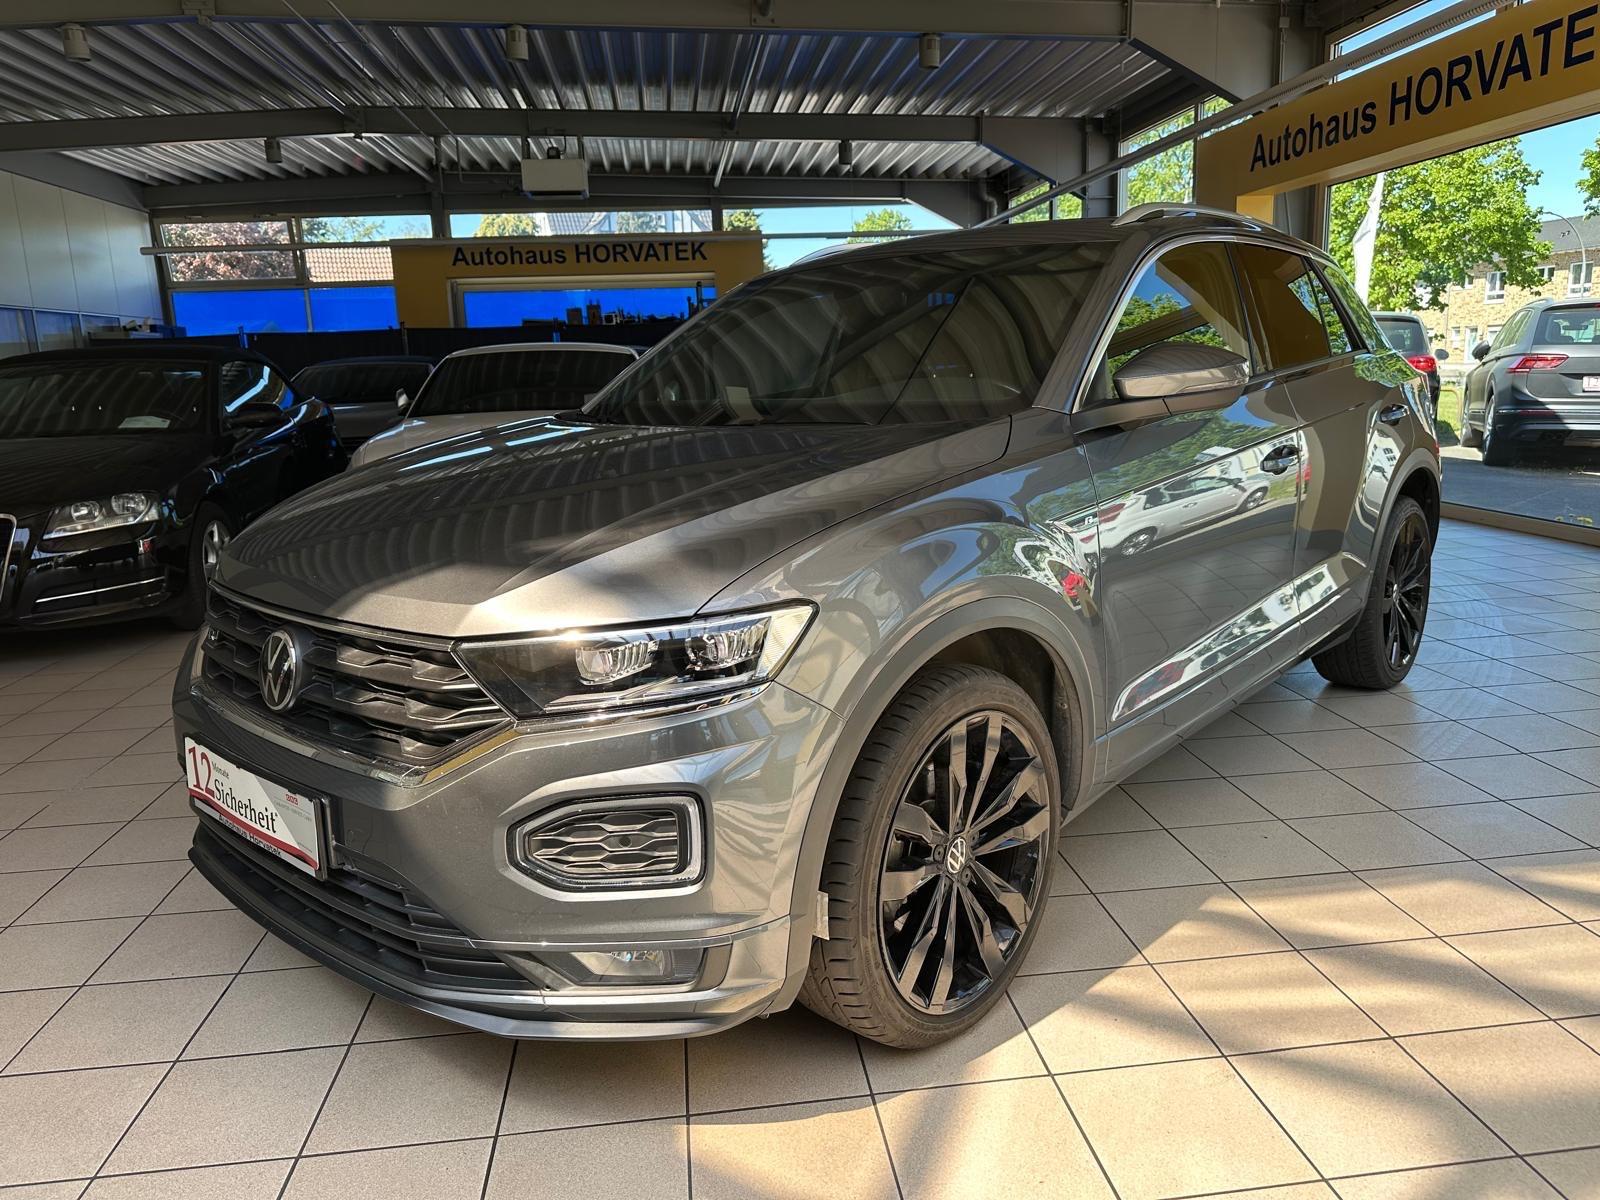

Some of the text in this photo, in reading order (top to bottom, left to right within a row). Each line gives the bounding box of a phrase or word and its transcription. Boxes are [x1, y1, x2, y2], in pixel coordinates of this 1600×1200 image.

[1250, 101, 1377, 172] Autohaus
[452, 242, 708, 266] Autohaus HORVATEK
[188, 746, 215, 798] 12
